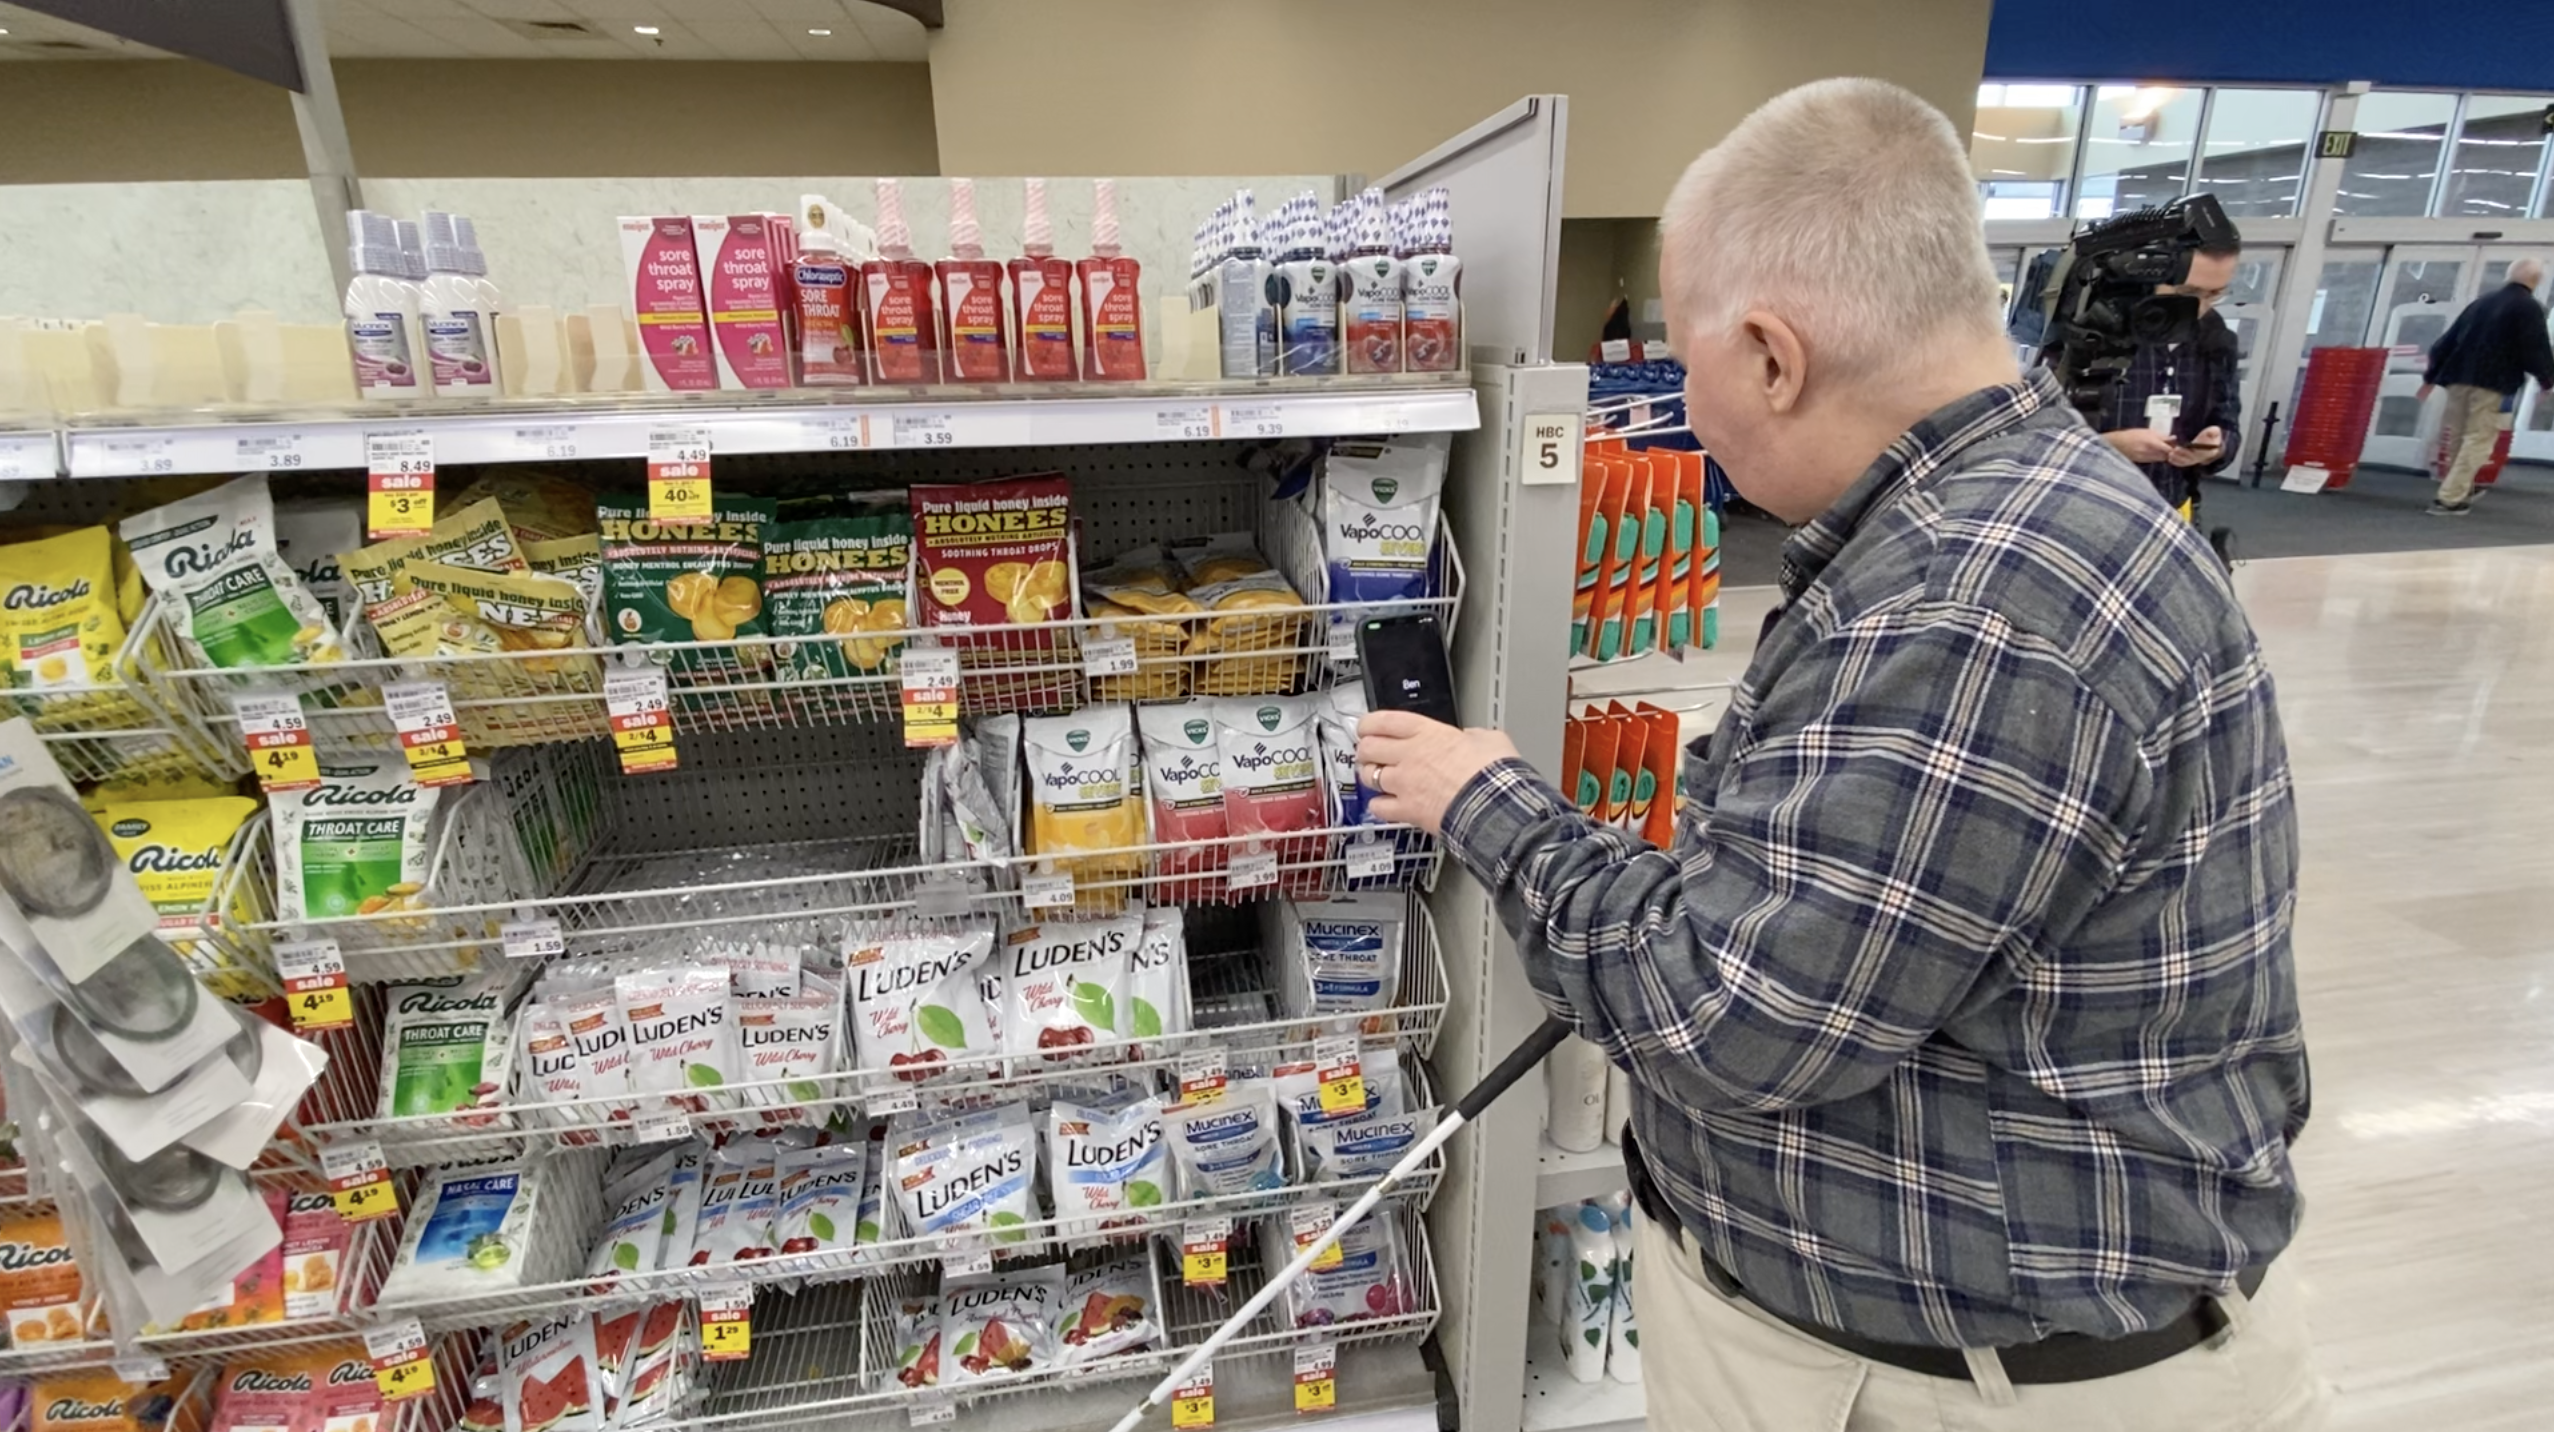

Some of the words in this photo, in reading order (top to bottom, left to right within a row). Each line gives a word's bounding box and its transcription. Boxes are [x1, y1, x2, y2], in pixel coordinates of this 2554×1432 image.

[2322, 133, 2350, 156] EXIT
[659, 249, 690, 262] sore
[734, 248, 766, 260] sore
[648, 263, 693, 275] throat
[723, 261, 769, 274] throat
[798, 269, 844, 284] Chloraseptic
[656, 278, 694, 293] spray
[732, 276, 770, 291] spray
[801, 289, 828, 303] SORE
[889, 296, 912, 305] sore
[971, 295, 993, 305] sore
[1042, 293, 1064, 303] sore
[1113, 293, 1133, 302] sore
[803, 304, 841, 317] THROAT
[882, 304, 913, 315] throat
[962, 304, 994, 314] throat
[1033, 302, 1065, 312] throat
[1104, 302, 1133, 312] throat
[886, 315, 914, 326] spray
[967, 314, 995, 325] spray
[1038, 312, 1065, 324] spray
[1108, 312, 1134, 323] spray
[1184, 425, 1210, 437] 6.19
[1256, 423, 1283, 435] 9.39
[1536, 426, 1564, 438] HBC
[830, 436, 858, 447] 6.19
[924, 432, 953, 445] 3.59
[547, 445, 576, 458] 6.19
[678, 449, 706, 462] 4.49
[1538, 443, 1560, 469] 5
[140, 459, 173, 472] 3.89
[270, 454, 302, 468] 3.89
[400, 460, 431, 473] 8.49
[660, 463, 699, 477] sale
[381, 474, 422, 489] sale
[391, 498, 410, 514] $3
[922, 501, 953, 515] Pure
[955, 499, 991, 515] liquid
[993, 498, 1030, 513] honey
[1032, 494, 1070, 508] inside
[597, 505, 633, 519] Pure
[724, 510, 768, 524] inside
[924, 508, 1067, 535] HONEES
[600, 518, 760, 543] HONEES
[764, 542, 791, 555] Pure
[793, 538, 830, 553] liquid
[832, 536, 868, 550] honey
[871, 534, 909, 548] inside
[933, 534, 983, 545] ABSOLUTELY
[941, 547, 990, 559] SOOTHING
[991, 545, 1026, 556] THROAT
[1027, 542, 1060, 554] DROPS
[351, 564, 384, 581] Pure
[425, 535, 467, 556] honey
[764, 546, 909, 574] HONEES
[226, 567, 265, 590] CARE
[4, 578, 91, 610] Ricola
[451, 582, 495, 601] liquid
[499, 590, 544, 611] honey
[940, 588, 961, 596] FREE
[938, 609, 972, 623] Honey
[1110, 659, 1135, 671] 1.99
[927, 675, 953, 688] 2.49
[1402, 678, 1421, 691] Ben
[913, 689, 947, 702] sale
[635, 698, 663, 712] 2.49
[272, 718, 302, 730] 4.59
[423, 713, 452, 727] 2.49
[621, 714, 658, 728] sale
[1260, 714, 1281, 722] VICKS
[410, 728, 449, 745] sale
[1187, 726, 1208, 735] VICKS
[258, 732, 299, 747] sale
[302, 783, 417, 807] Ricola
[308, 821, 364, 836] THROAT
[366, 820, 399, 835] CARE
[1370, 862, 1392, 873] 4.09
[1254, 872, 1276, 884] 3.99
[1050, 892, 1073, 904] 4.09
[1306, 921, 1380, 936] Mucinex
[534, 941, 561, 953] 1.59
[1014, 931, 1125, 979] LUDEN'S
[1339, 953, 1377, 962] THROAT
[312, 962, 341, 974] 4.59
[296, 975, 335, 991] sale
[859, 951, 972, 1003] LUDEN'S
[1023, 981, 1055, 1001] Wild
[399, 990, 498, 1014] Ricola
[1029, 994, 1064, 1013] Cherry
[869, 1007, 899, 1026] Wild
[633, 1005, 723, 1045] LUDEN'S
[876, 1021, 909, 1039] Cherry
[404, 1027, 449, 1041] THROAT
[452, 1025, 484, 1039] CARE
[742, 1024, 831, 1048] LUDEN'S
[650, 1045, 679, 1061] Wild
[679, 1038, 714, 1055] Cherry
[753, 1052, 784, 1067] Wild
[784, 1048, 817, 1064] Cherry
[1336, 1055, 1357, 1066] 5.29
[1202, 1068, 1222, 1078] 3.49
[1326, 1067, 1353, 1079] sale
[1190, 1079, 1217, 1090] sale
[1334, 1084, 1348, 1096] $3
[891, 1099, 915, 1111] 4.49
[1186, 1111, 1254, 1134] Mucinex
[665, 1125, 690, 1137] 1.59
[1337, 1121, 1414, 1144] Mucinex
[1068, 1120, 1163, 1166] LUDEN'S
[1195, 1143, 1218, 1152] SORE
[355, 1160, 383, 1172] 4.59
[1341, 1156, 1368, 1164] SORE
[341, 1173, 379, 1189] sale
[484, 1177, 514, 1190] CARE
[917, 1150, 1021, 1218] LUDEN'S
[780, 1171, 857, 1206] LUDEN'S
[1082, 1186, 1109, 1200] Wild
[1089, 1198, 1120, 1210] Cherry
[1204, 1232, 1224, 1242] 3.49
[1191, 1243, 1218, 1253] sale
[968, 1263, 990, 1272] 4.59
[1198, 1258, 1211, 1269] $3
[725, 1300, 747, 1310] 1.59
[951, 1286, 1048, 1316] LUDEN'S
[711, 1311, 742, 1321] sale
[397, 1337, 423, 1349] 4.59
[383, 1350, 419, 1367] sale
[1314, 1361, 1332, 1371] 4.99
[233, 1370, 312, 1393] Ricola
[1302, 1370, 1327, 1381] sale
[1191, 1378, 1211, 1388] 3.49
[1180, 1388, 1206, 1398] sale
[1308, 1386, 1321, 1397] $3
[46, 1399, 123, 1420] Ricola
[1185, 1402, 1199, 1413] $3
[932, 1413, 953, 1421] 4.49
